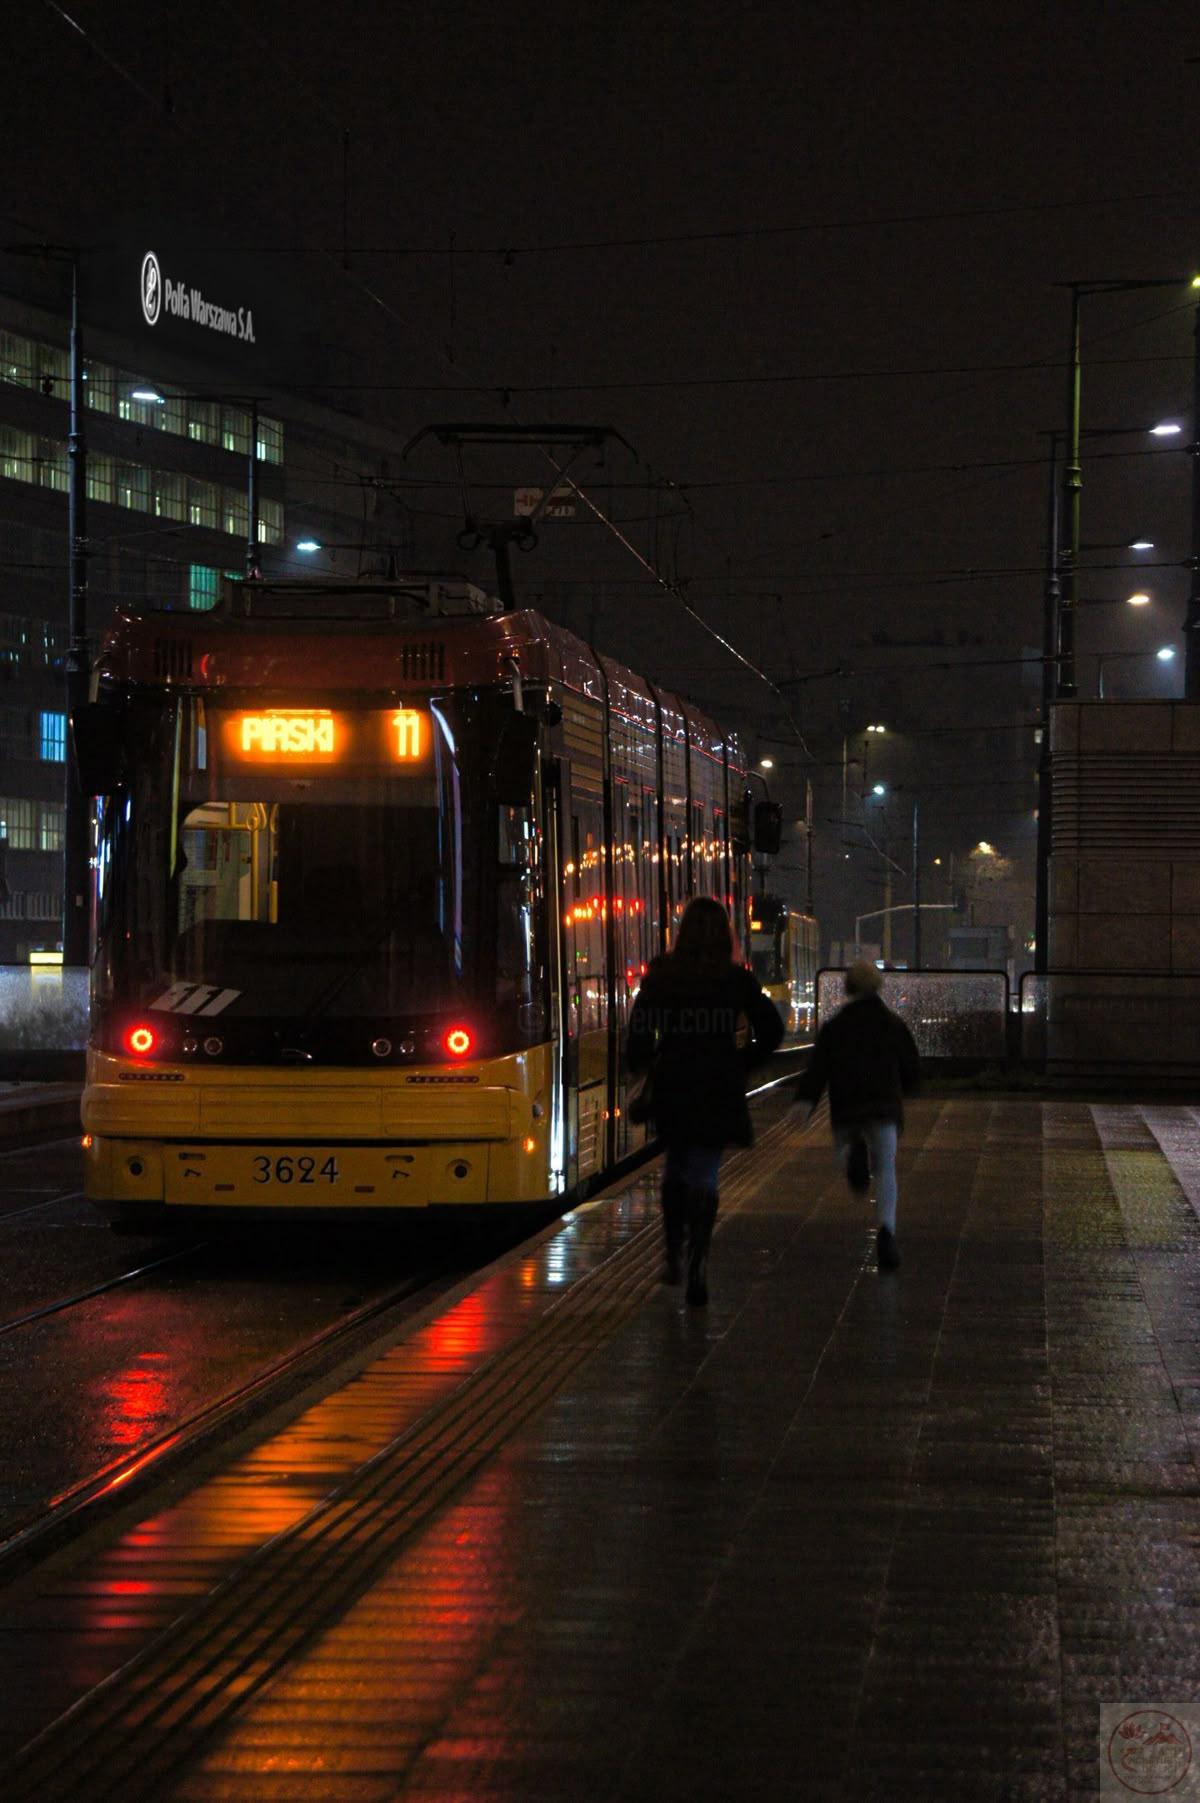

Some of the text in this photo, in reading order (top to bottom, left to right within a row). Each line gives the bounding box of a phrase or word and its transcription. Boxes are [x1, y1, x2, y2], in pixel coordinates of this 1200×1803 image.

[164, 278, 190, 320] Polfa
[190, 288, 237, 336] Warszawa
[392, 714, 421, 758] 11
[252, 1155, 340, 1184] 3624
